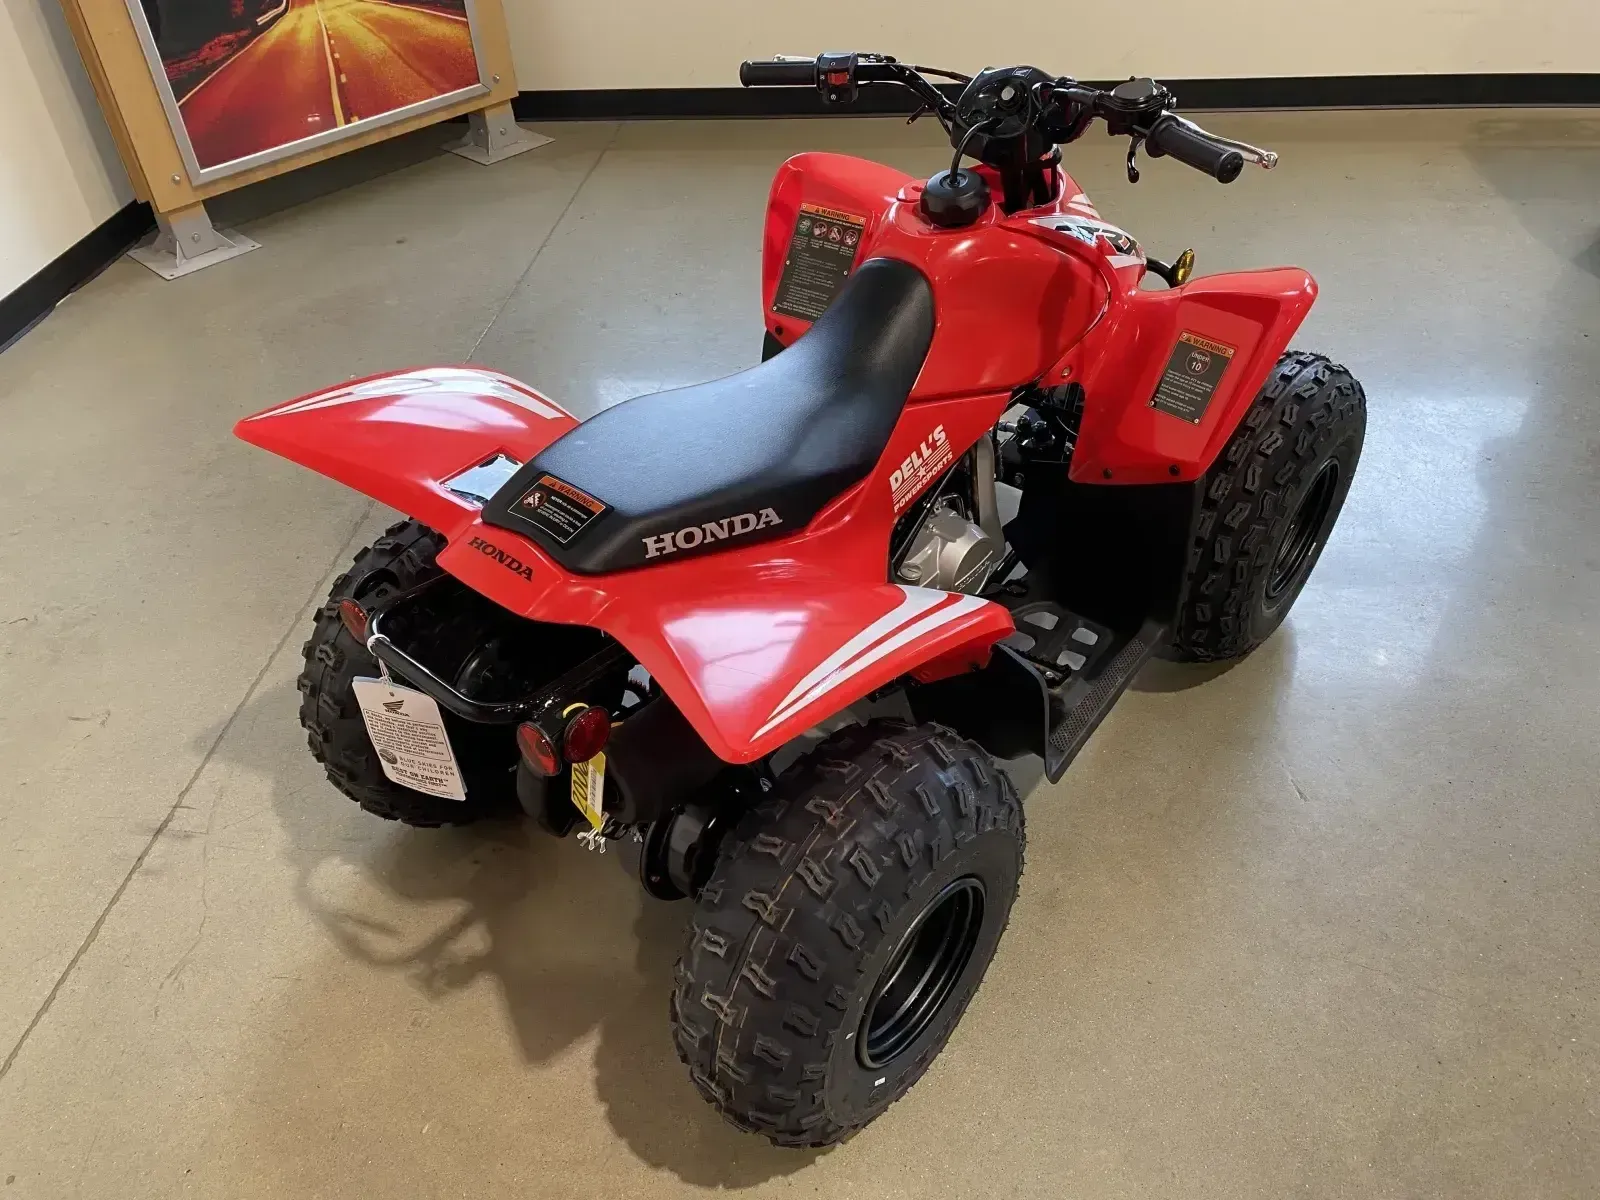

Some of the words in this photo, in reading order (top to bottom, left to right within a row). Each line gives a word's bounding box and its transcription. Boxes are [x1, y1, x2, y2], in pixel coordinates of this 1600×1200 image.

[822, 208, 850, 220] WARNING
[1192, 352, 1210, 362] UNDER
[1193, 338, 1227, 354] WARNING
[1191, 361, 1202, 371] 10
[889, 424, 946, 492] DELL'S
[894, 451, 953, 513] POWERSPORTS
[558, 485, 593, 507] WARNING
[642, 507, 783, 558] HONDA
[468, 536, 533, 582] HONDA
